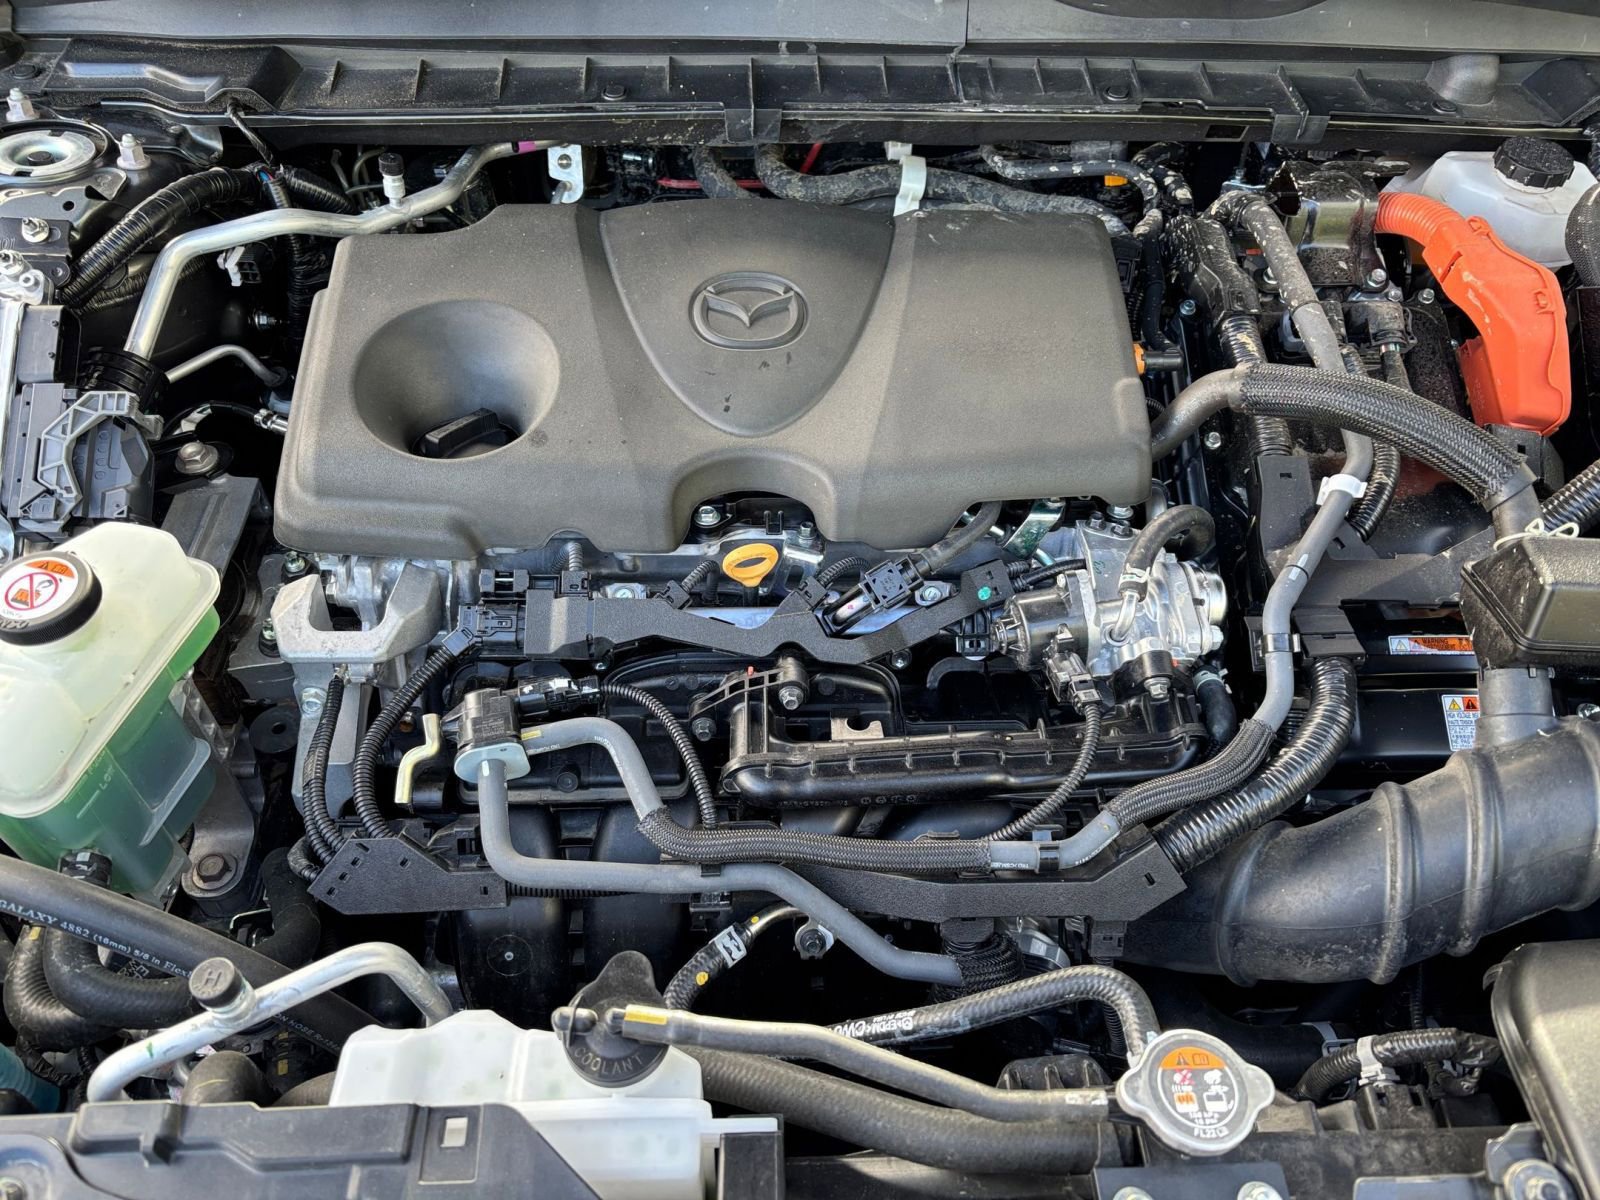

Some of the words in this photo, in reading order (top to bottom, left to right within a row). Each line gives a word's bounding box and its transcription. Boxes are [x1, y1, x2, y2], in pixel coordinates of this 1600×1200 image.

[0, 899, 58, 925] GALAXY
[60, 921, 91, 938] 4882
[574, 1047, 643, 1075] COOLANT
